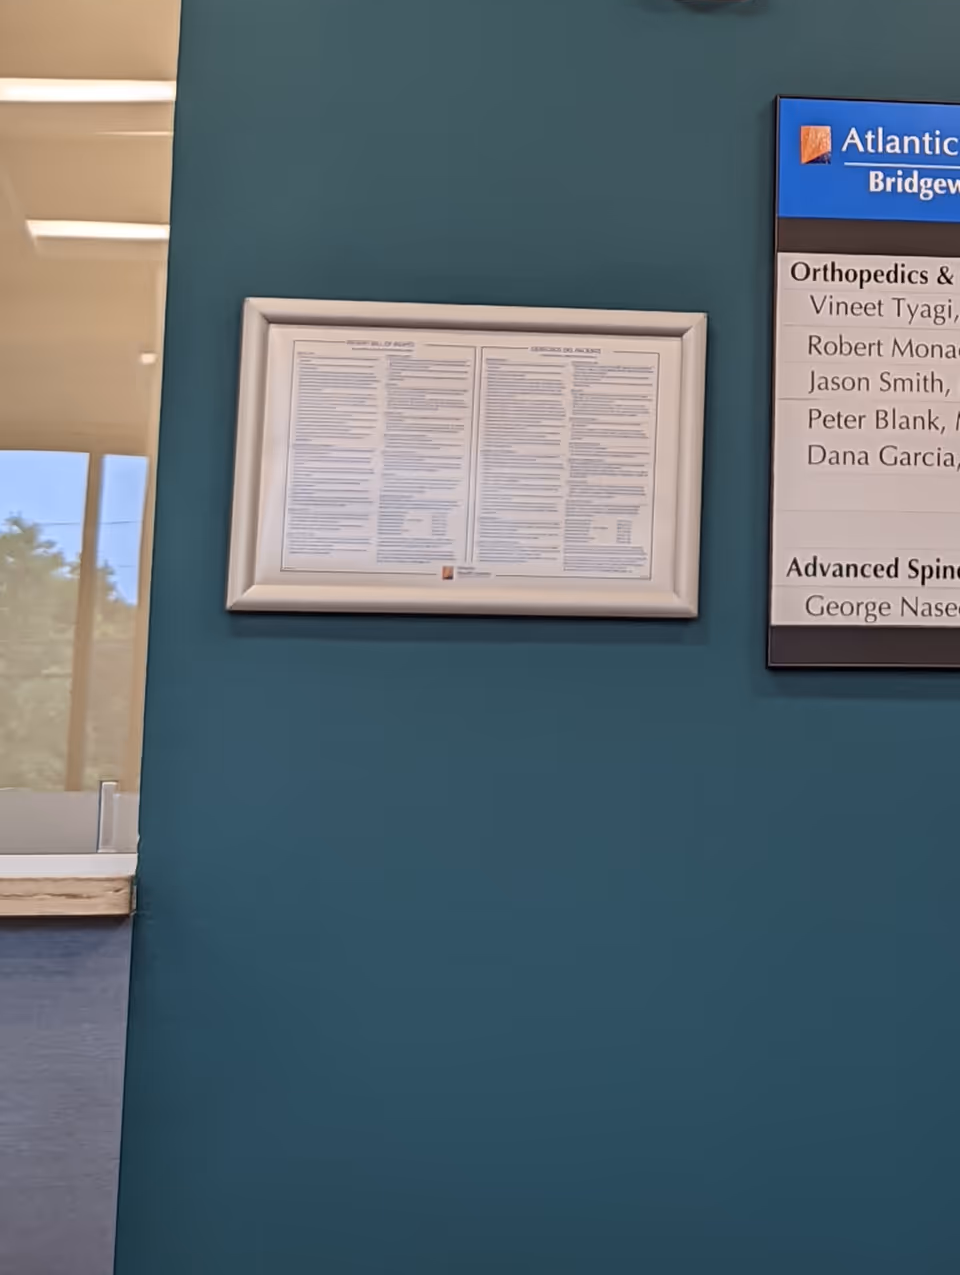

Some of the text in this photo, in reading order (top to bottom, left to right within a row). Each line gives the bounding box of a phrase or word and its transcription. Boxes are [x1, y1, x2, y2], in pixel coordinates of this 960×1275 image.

[841, 126, 959, 157] Atlantic
[790, 261, 929, 290] Orthopedics
[937, 266, 954, 286] &
[809, 295, 884, 318] Vineet
[891, 297, 960, 325] Tyagi,
[808, 334, 884, 357] Robert
[808, 370, 870, 394] Jason
[878, 371, 951, 397] Smith,
[808, 409, 866, 431] Peter
[875, 409, 946, 434] Blank,
[807, 444, 870, 467] Dana
[786, 555, 899, 580] Advanced
[805, 594, 892, 623] George
